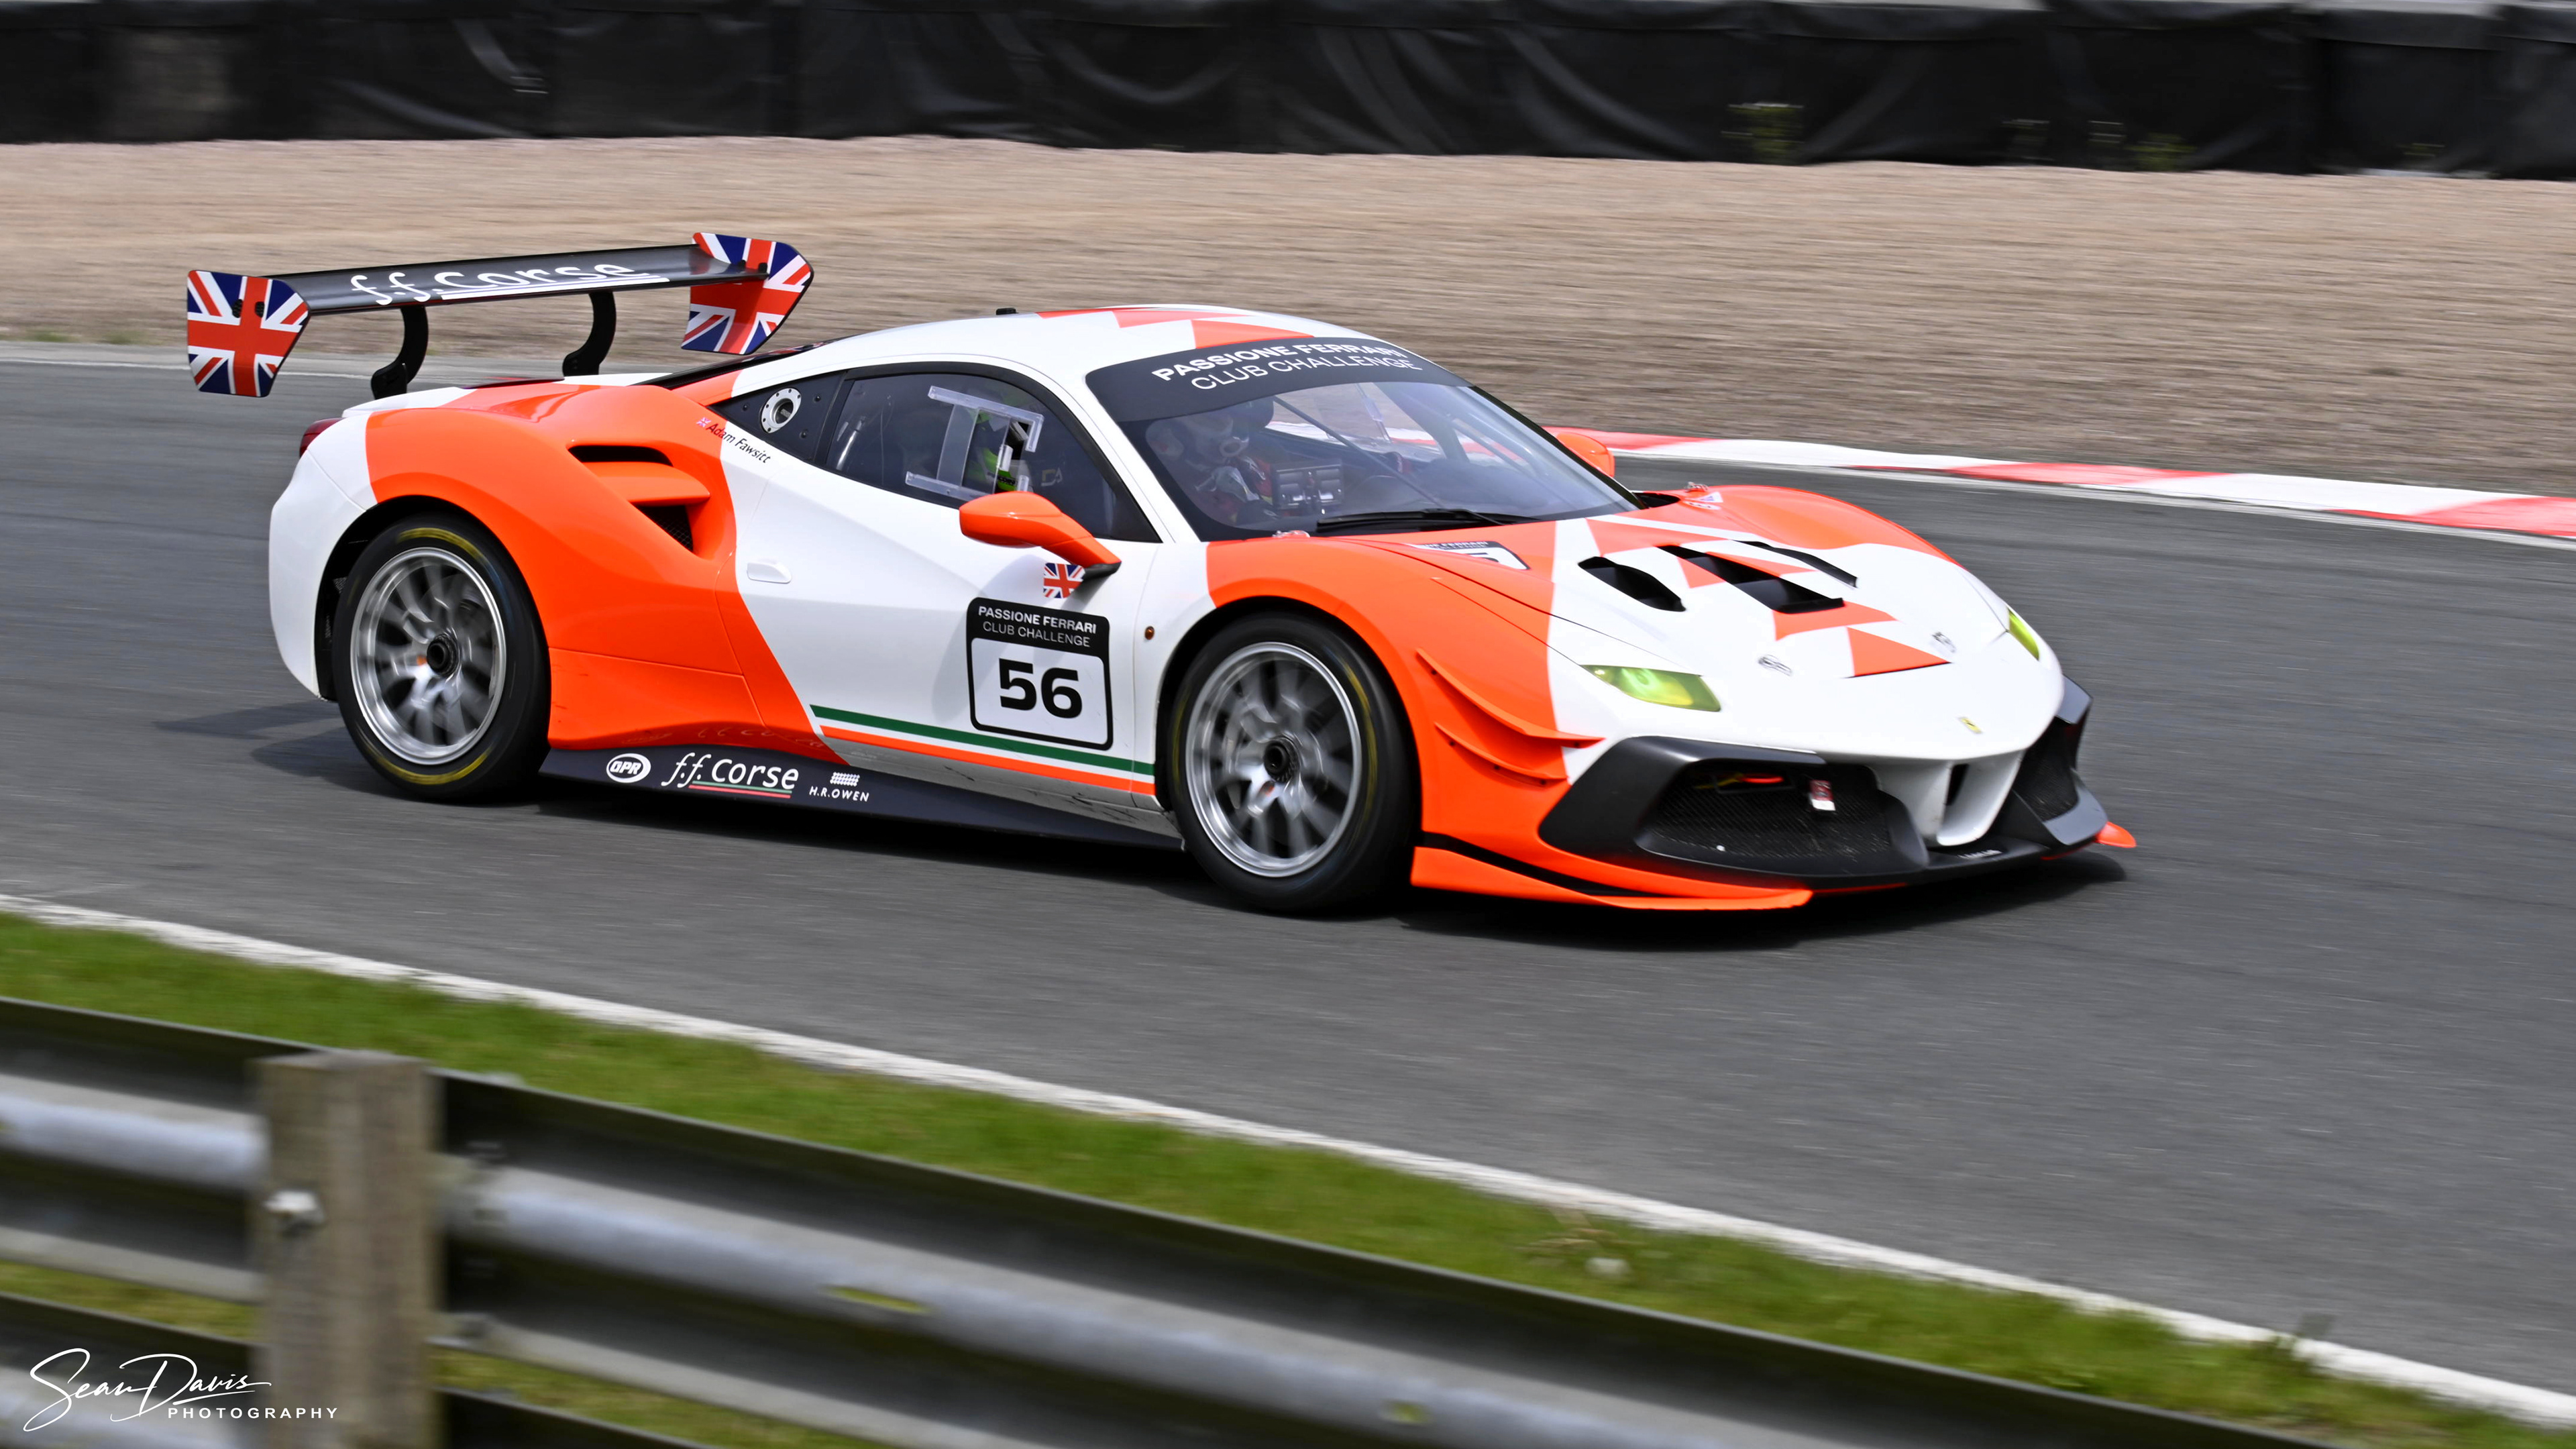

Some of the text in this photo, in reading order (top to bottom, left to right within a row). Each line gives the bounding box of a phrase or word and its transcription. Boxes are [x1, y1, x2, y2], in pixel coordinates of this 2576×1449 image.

[1152, 343, 1408, 381] PASSIONE FERRARI
[1191, 356, 1424, 390] CLUB CHALLENGE
[706, 423, 771, 464] Adam Fawsitt
[978, 606, 1097, 634] PASSIONE FERRARI
[983, 621, 1091, 647] CLUB CHALLENGE
[999, 657, 1083, 719] 56
